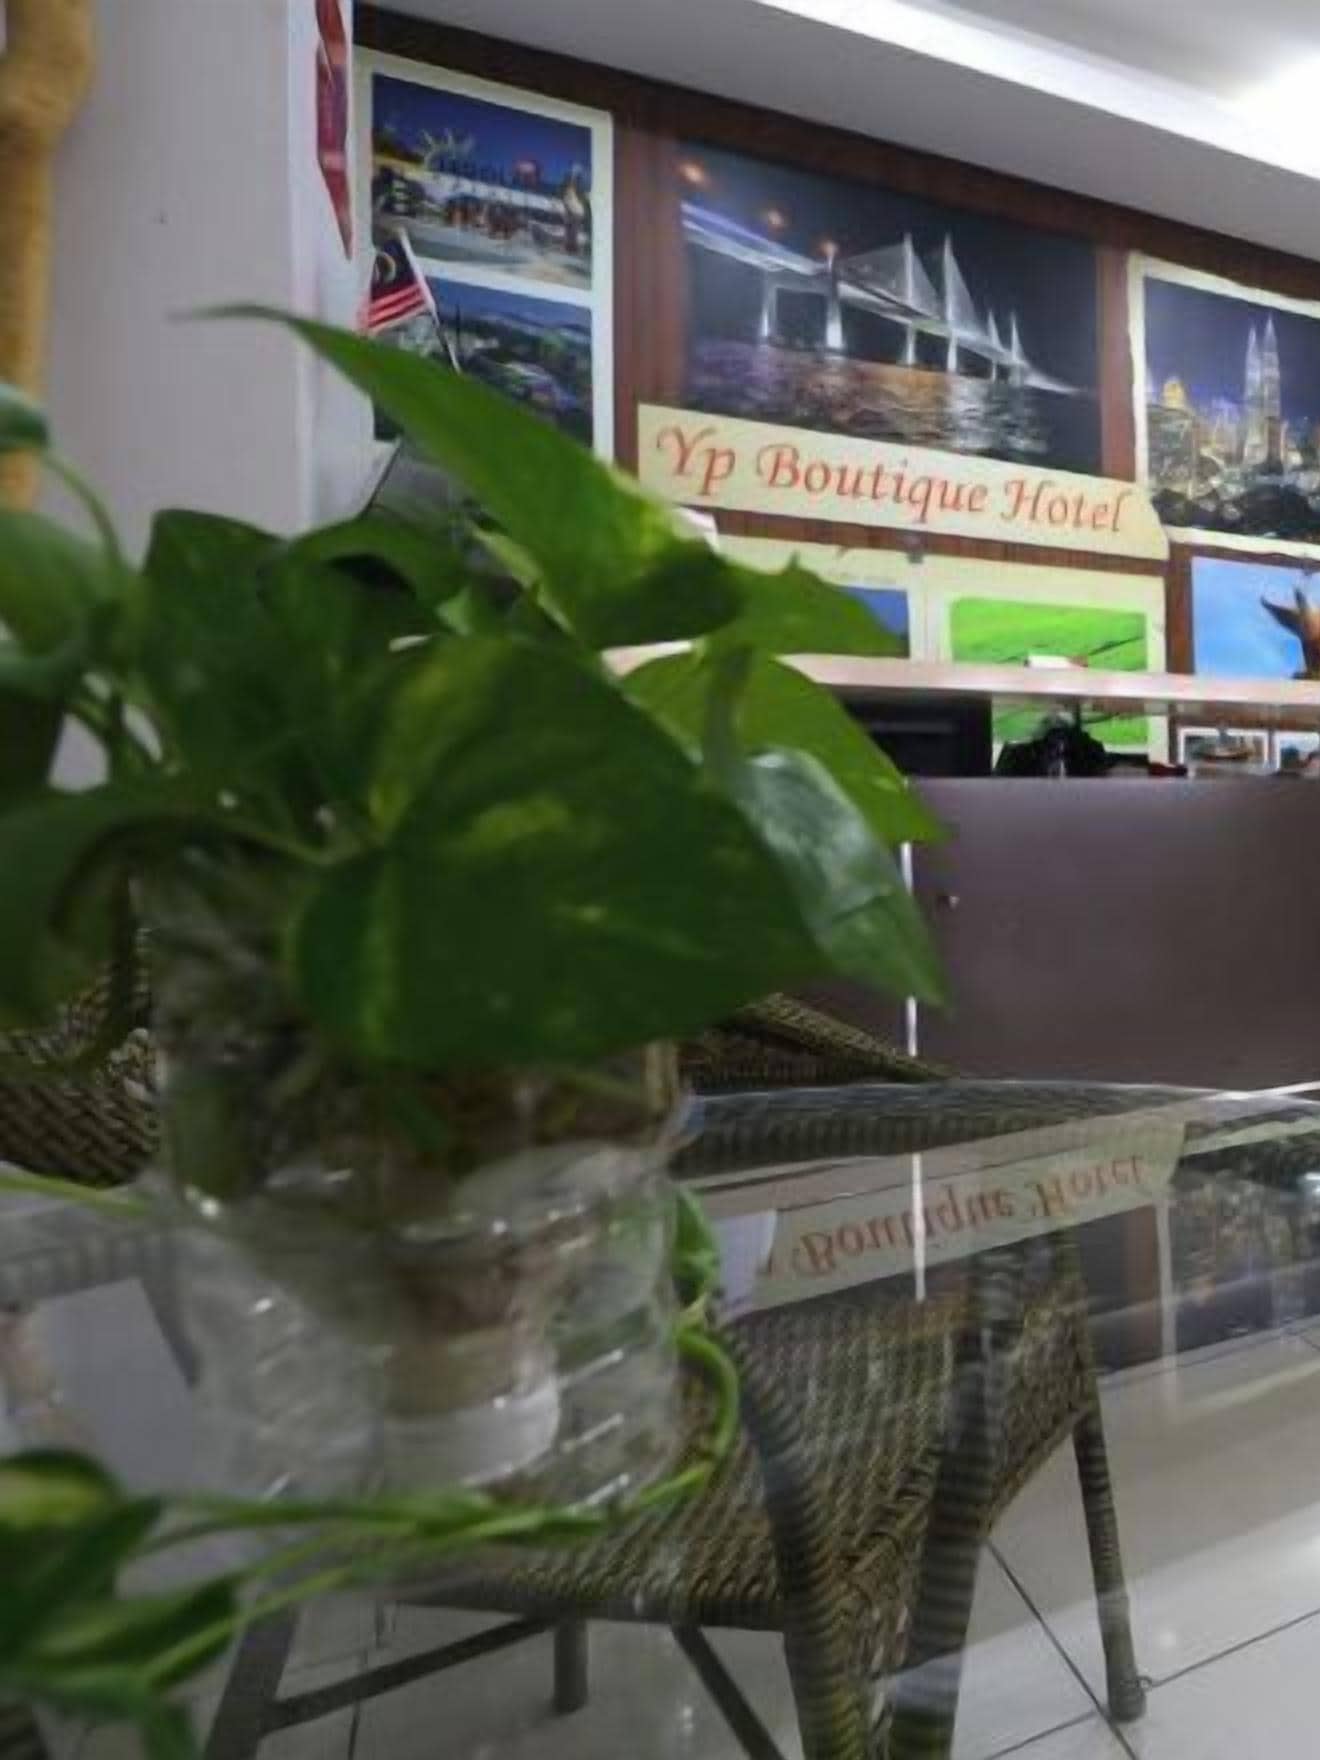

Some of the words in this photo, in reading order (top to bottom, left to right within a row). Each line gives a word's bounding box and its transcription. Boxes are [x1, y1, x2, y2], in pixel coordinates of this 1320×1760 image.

[655, 423, 737, 496] Yp
[755, 444, 990, 523] Boutique
[999, 477, 1135, 534] Hotel
